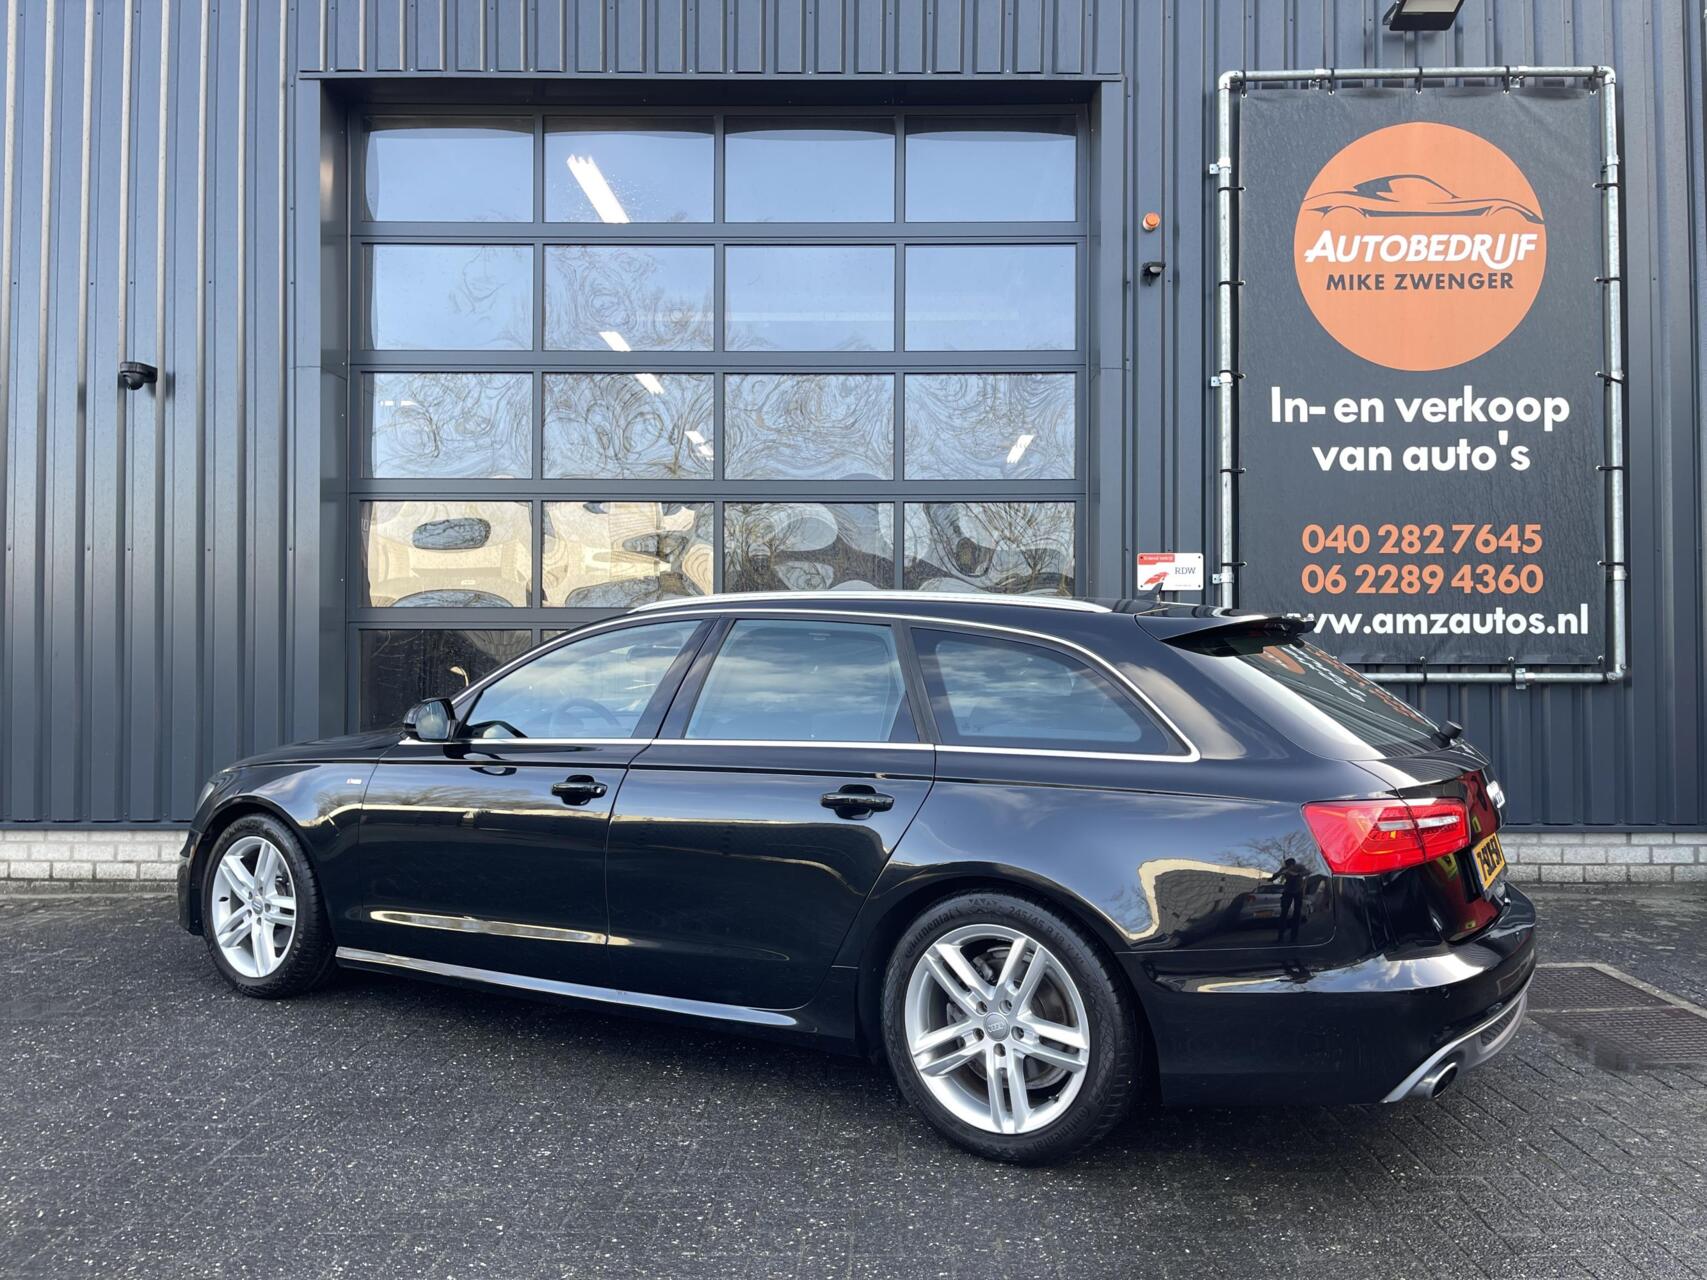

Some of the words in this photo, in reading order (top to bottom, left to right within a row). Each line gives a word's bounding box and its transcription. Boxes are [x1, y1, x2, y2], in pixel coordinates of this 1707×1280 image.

[1304, 230, 1538, 270] AUTOBEDRIJF
[1326, 273, 1385, 291] MIKE
[1394, 272, 1514, 291] ZWENGER
[1271, 386, 1326, 423] In-
[1334, 396, 1384, 423] en
[1394, 385, 1570, 432] verkoop
[1312, 446, 1392, 472] van
[1402, 430, 1531, 472] auto's
[1302, 524, 1370, 554] 040
[1378, 524, 1444, 554] 282
[1452, 524, 1543, 554] 7645
[1174, 566, 1196, 575] RDW
[1301, 564, 1347, 594] 06
[1355, 564, 1445, 594] 2289
[1451, 564, 1544, 594] 4360
[1283, 604, 1588, 634] ww.amzautos.nl
